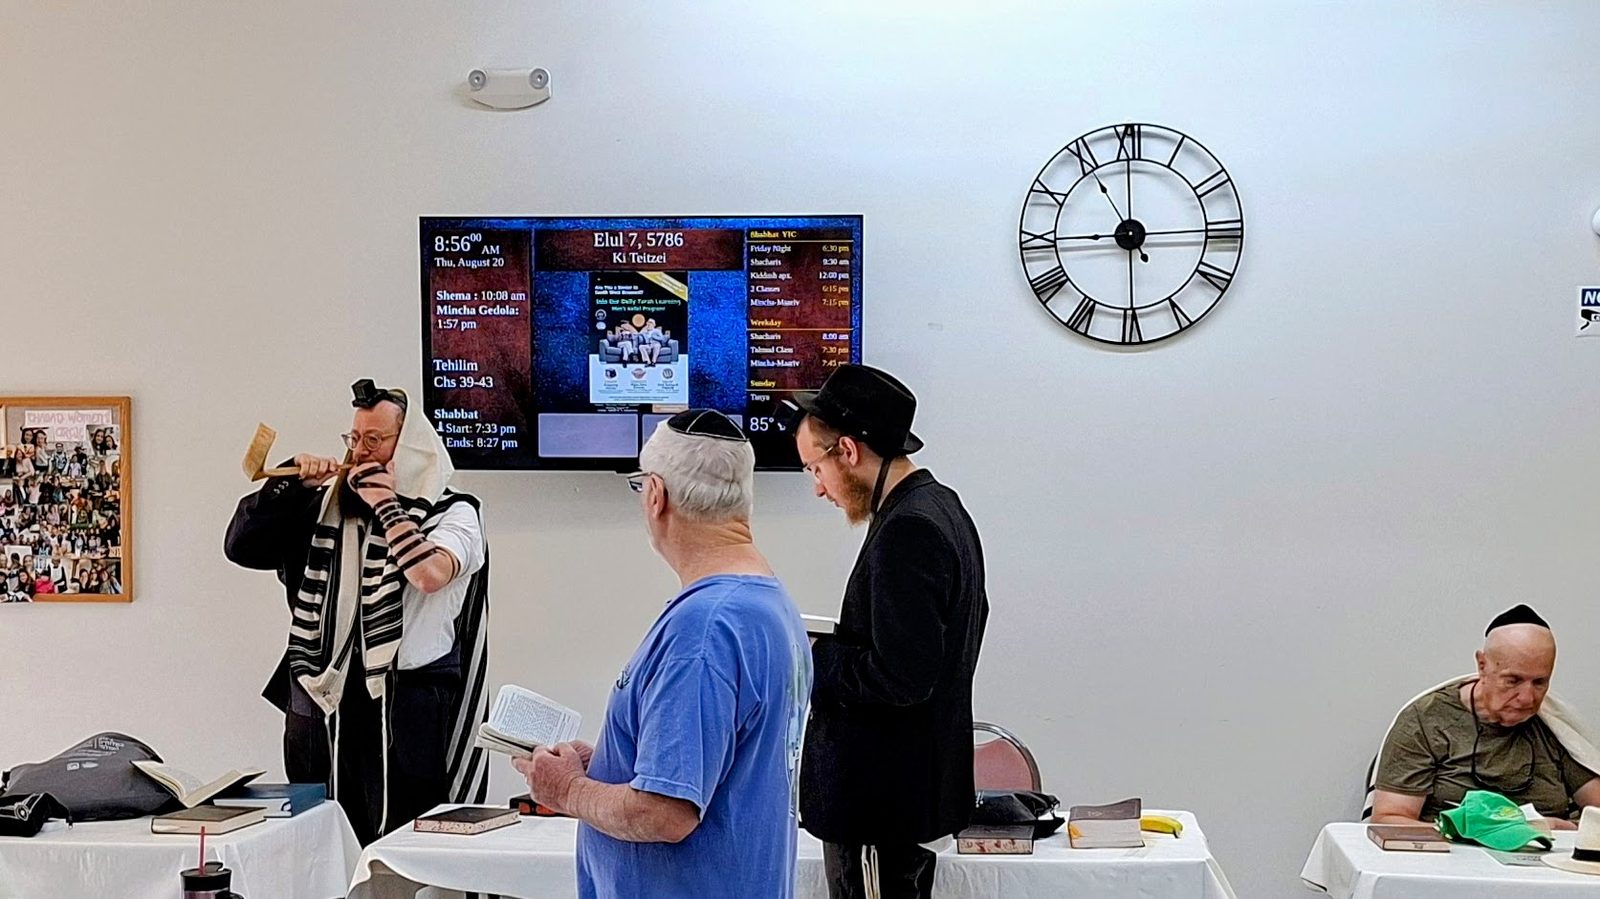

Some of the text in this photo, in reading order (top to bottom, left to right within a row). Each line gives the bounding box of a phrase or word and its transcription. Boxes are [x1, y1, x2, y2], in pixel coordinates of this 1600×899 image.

[594, 233, 683, 249] Elul 7, 5786
[482, 245, 500, 254] AM
[750, 245, 771, 254] Friday
[773, 245, 791, 253] Night
[435, 258, 504, 269] Thu, August 20
[613, 253, 666, 263] Ki Teitzei
[436, 291, 471, 300] Shema
[481, 291, 508, 300] 10:08
[436, 306, 519, 315] Mincha Gedola:
[438, 319, 476, 331] 1:57 pm
[433, 359, 478, 371] Tehilim
[434, 376, 493, 387] Chs 39-43
[434, 409, 478, 419] Shabbat
[446, 423, 516, 436] Start: 7:33 pm
[750, 417, 774, 431] 85°
[446, 437, 518, 450] Ends: 8:27 pm
